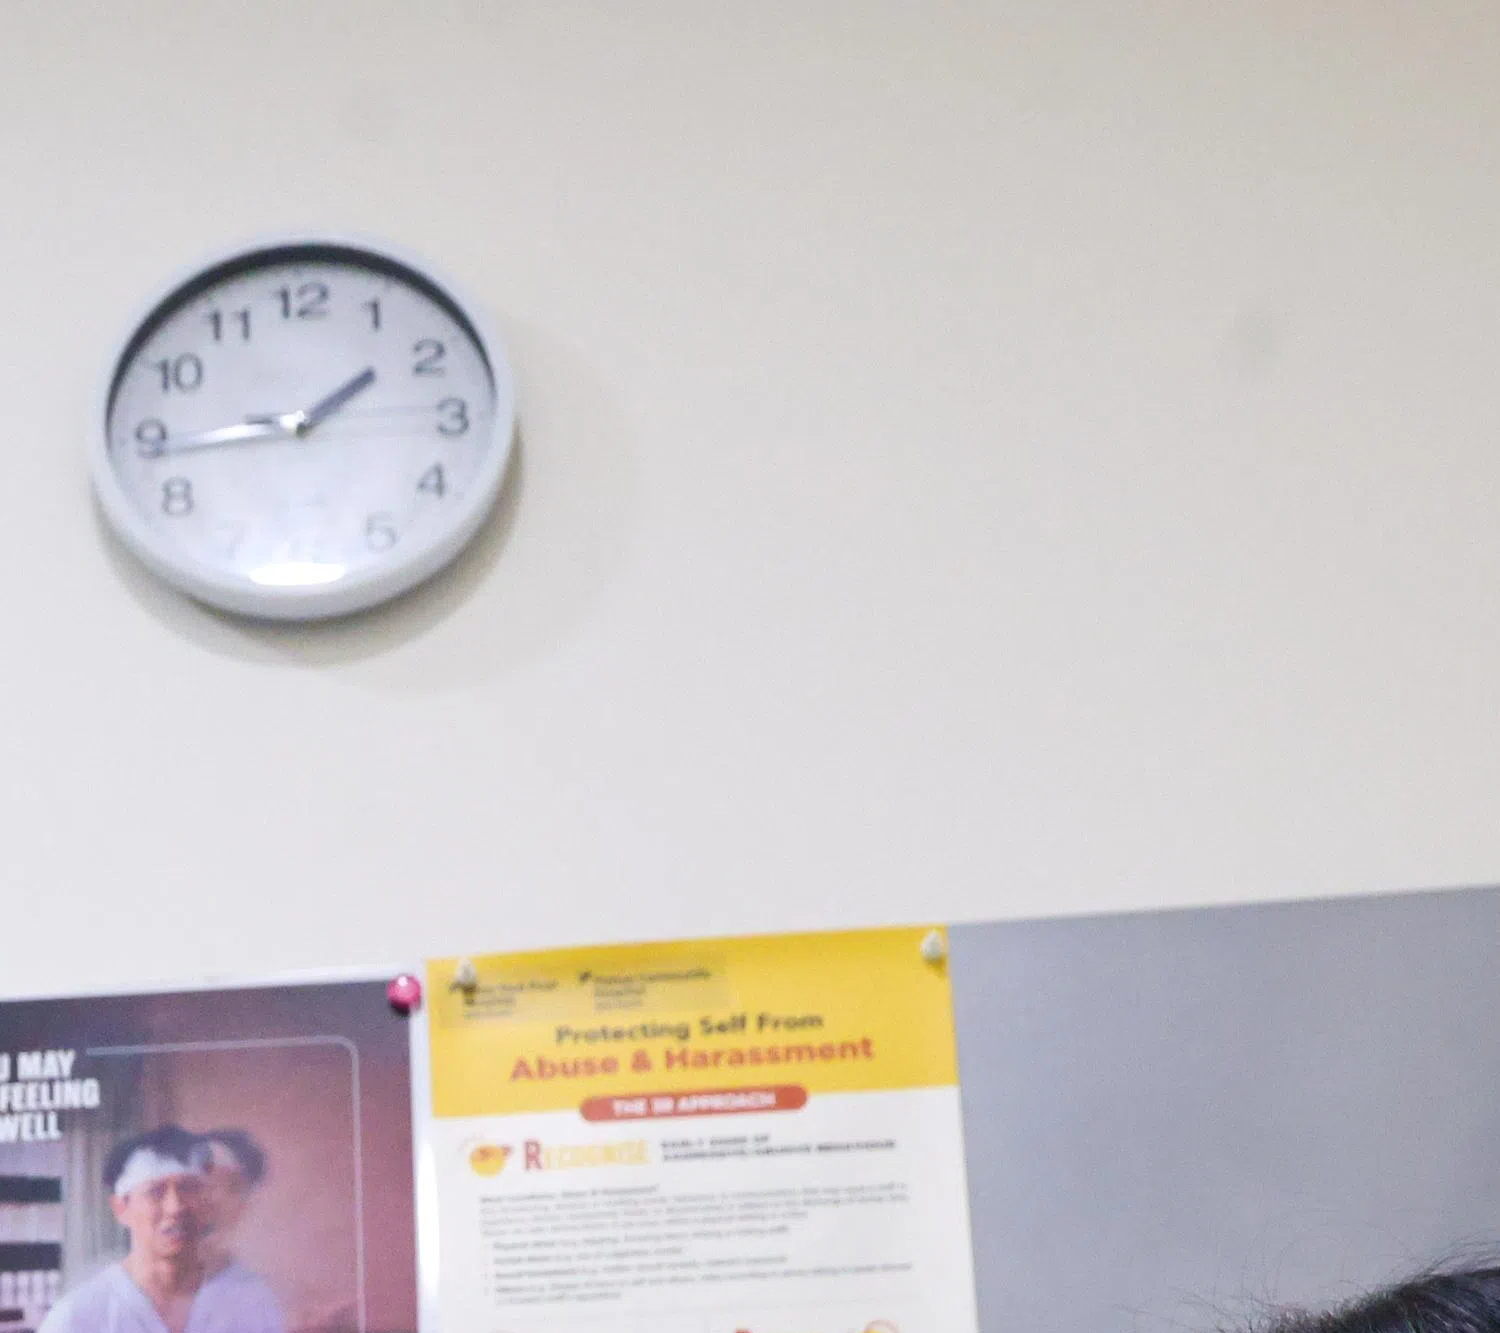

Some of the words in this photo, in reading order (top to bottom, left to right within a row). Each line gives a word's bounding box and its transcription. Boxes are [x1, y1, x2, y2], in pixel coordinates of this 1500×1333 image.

[273, 281, 330, 320] 12
[366, 298, 381, 330] 1
[205, 308, 251, 341] 11
[154, 352, 204, 393] 10
[412, 338, 447, 376] 2
[436, 397, 471, 438] 3
[133, 418, 168, 459] 9
[160, 477, 195, 517] 8
[416, 462, 446, 499] 4
[364, 511, 398, 552] 5
[556, 1022, 691, 1047] Protecting
[700, 1013, 748, 1036] Self
[757, 1010, 824, 1033] From
[16, 1048, 77, 1080] MAY
[509, 1056, 620, 1083] Abuse
[631, 1048, 653, 1073] &
[664, 1036, 875, 1072] Harassment
